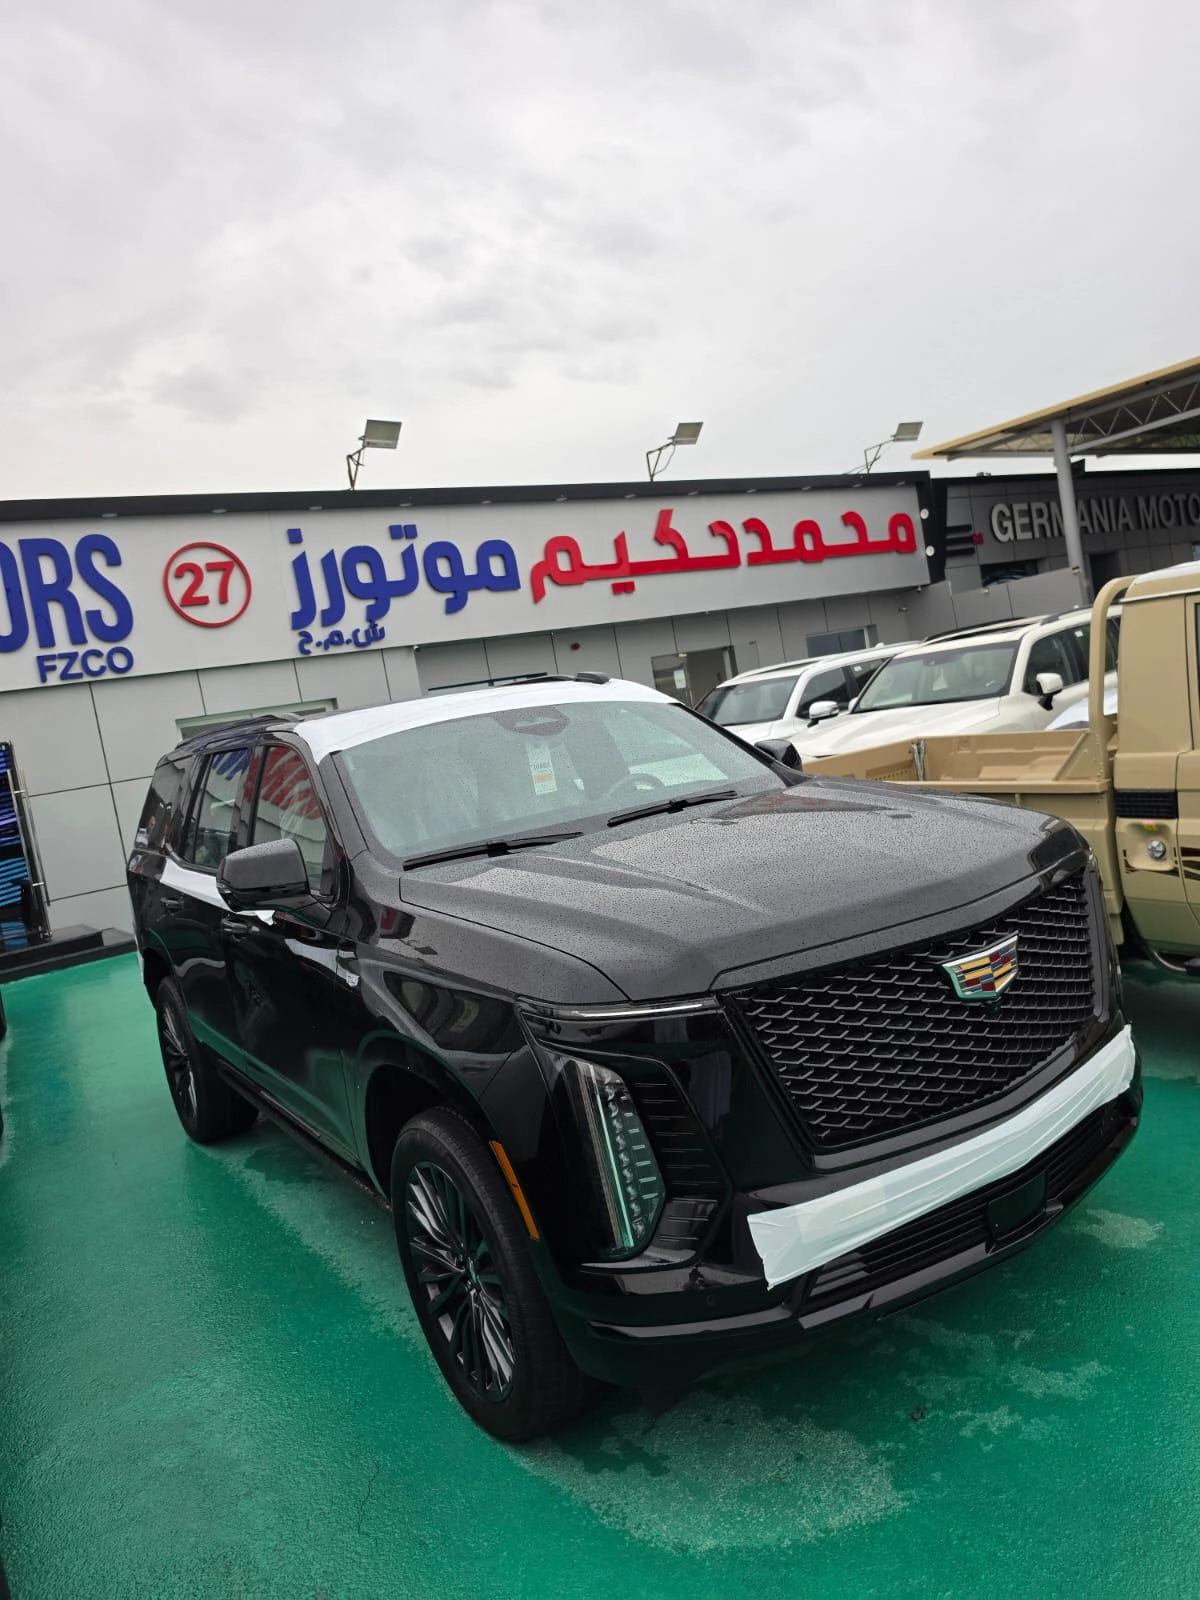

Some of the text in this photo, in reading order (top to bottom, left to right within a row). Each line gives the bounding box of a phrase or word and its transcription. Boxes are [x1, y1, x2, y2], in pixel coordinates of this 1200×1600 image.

[174, 561, 235, 607] 27
[287, 508, 917, 630] محمد حكيم موتورز
[36, 646, 134, 683] FZCO
